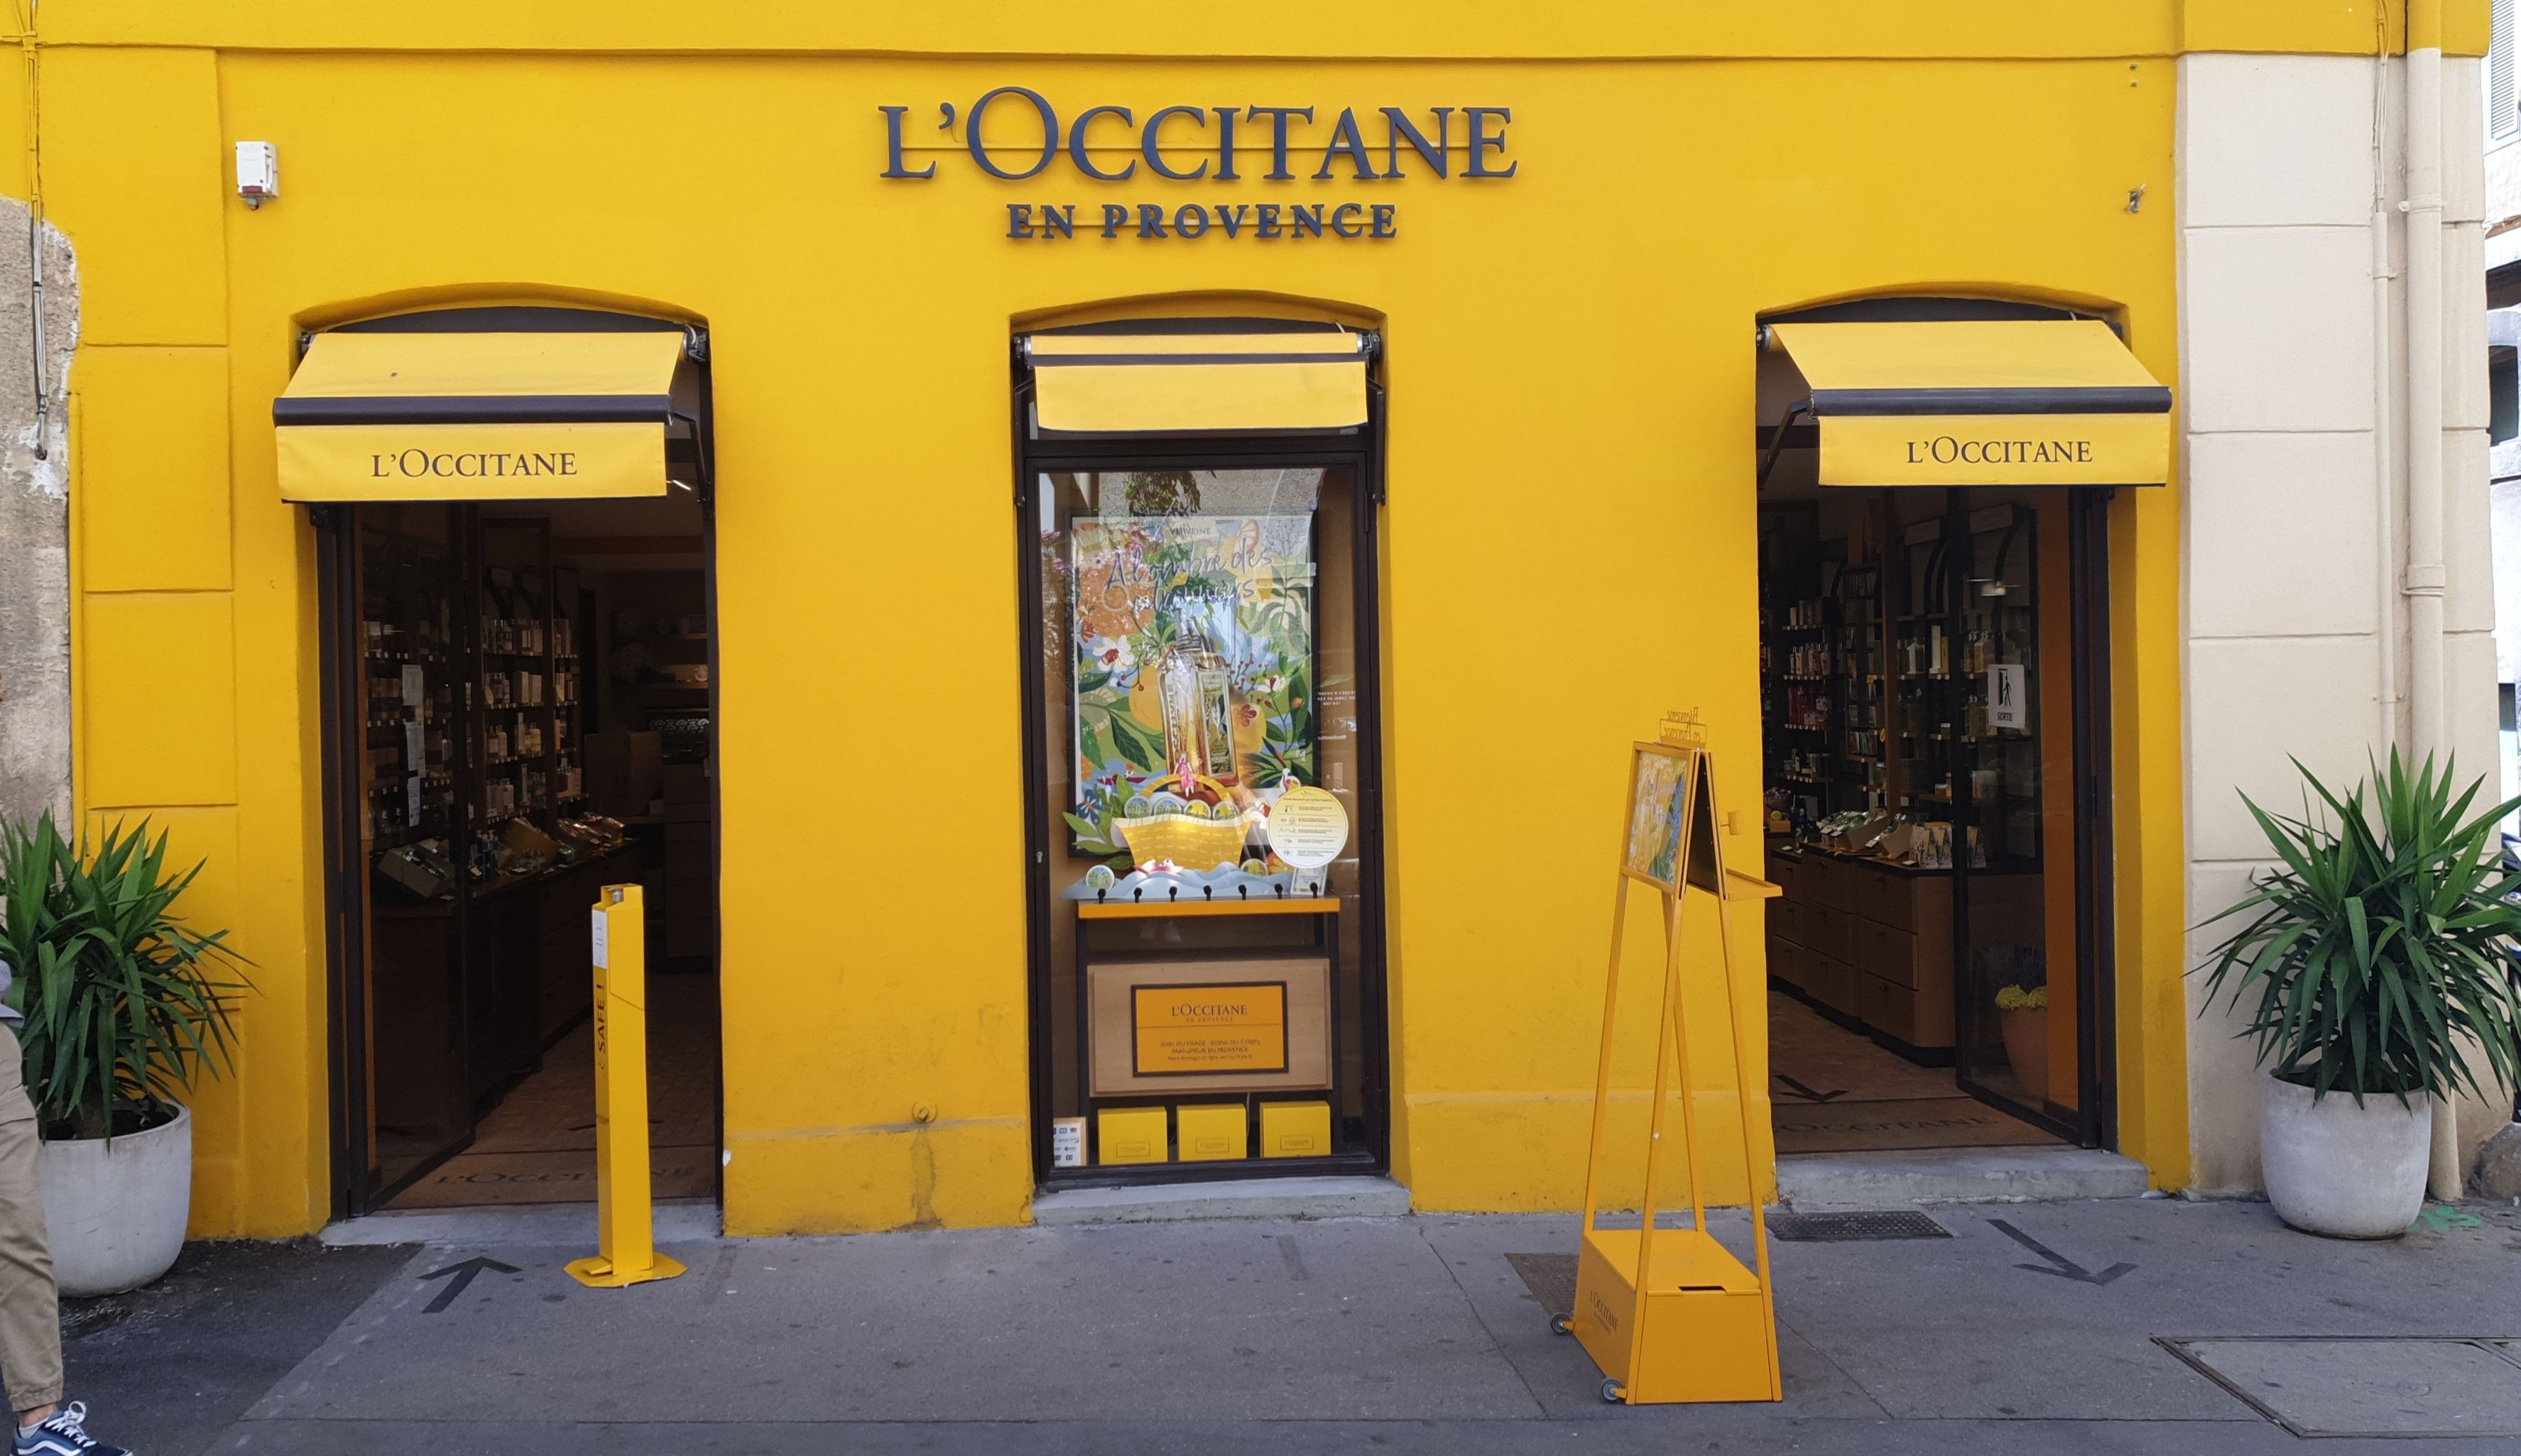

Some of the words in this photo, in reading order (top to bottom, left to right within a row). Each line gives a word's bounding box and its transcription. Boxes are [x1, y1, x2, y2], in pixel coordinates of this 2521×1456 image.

[878, 86, 1518, 181] L'OCCITANE
[1006, 204, 1076, 240] EN
[1101, 203, 1398, 239] PROVENCE
[371, 448, 578, 478] L'OCCITANE
[1907, 436, 2093, 464] L'OCCITANE
[1997, 712, 2013, 721] SORTIE
[1172, 1004, 1248, 1017] L'OCCITANE
[597, 999, 606, 1054] SAFE
